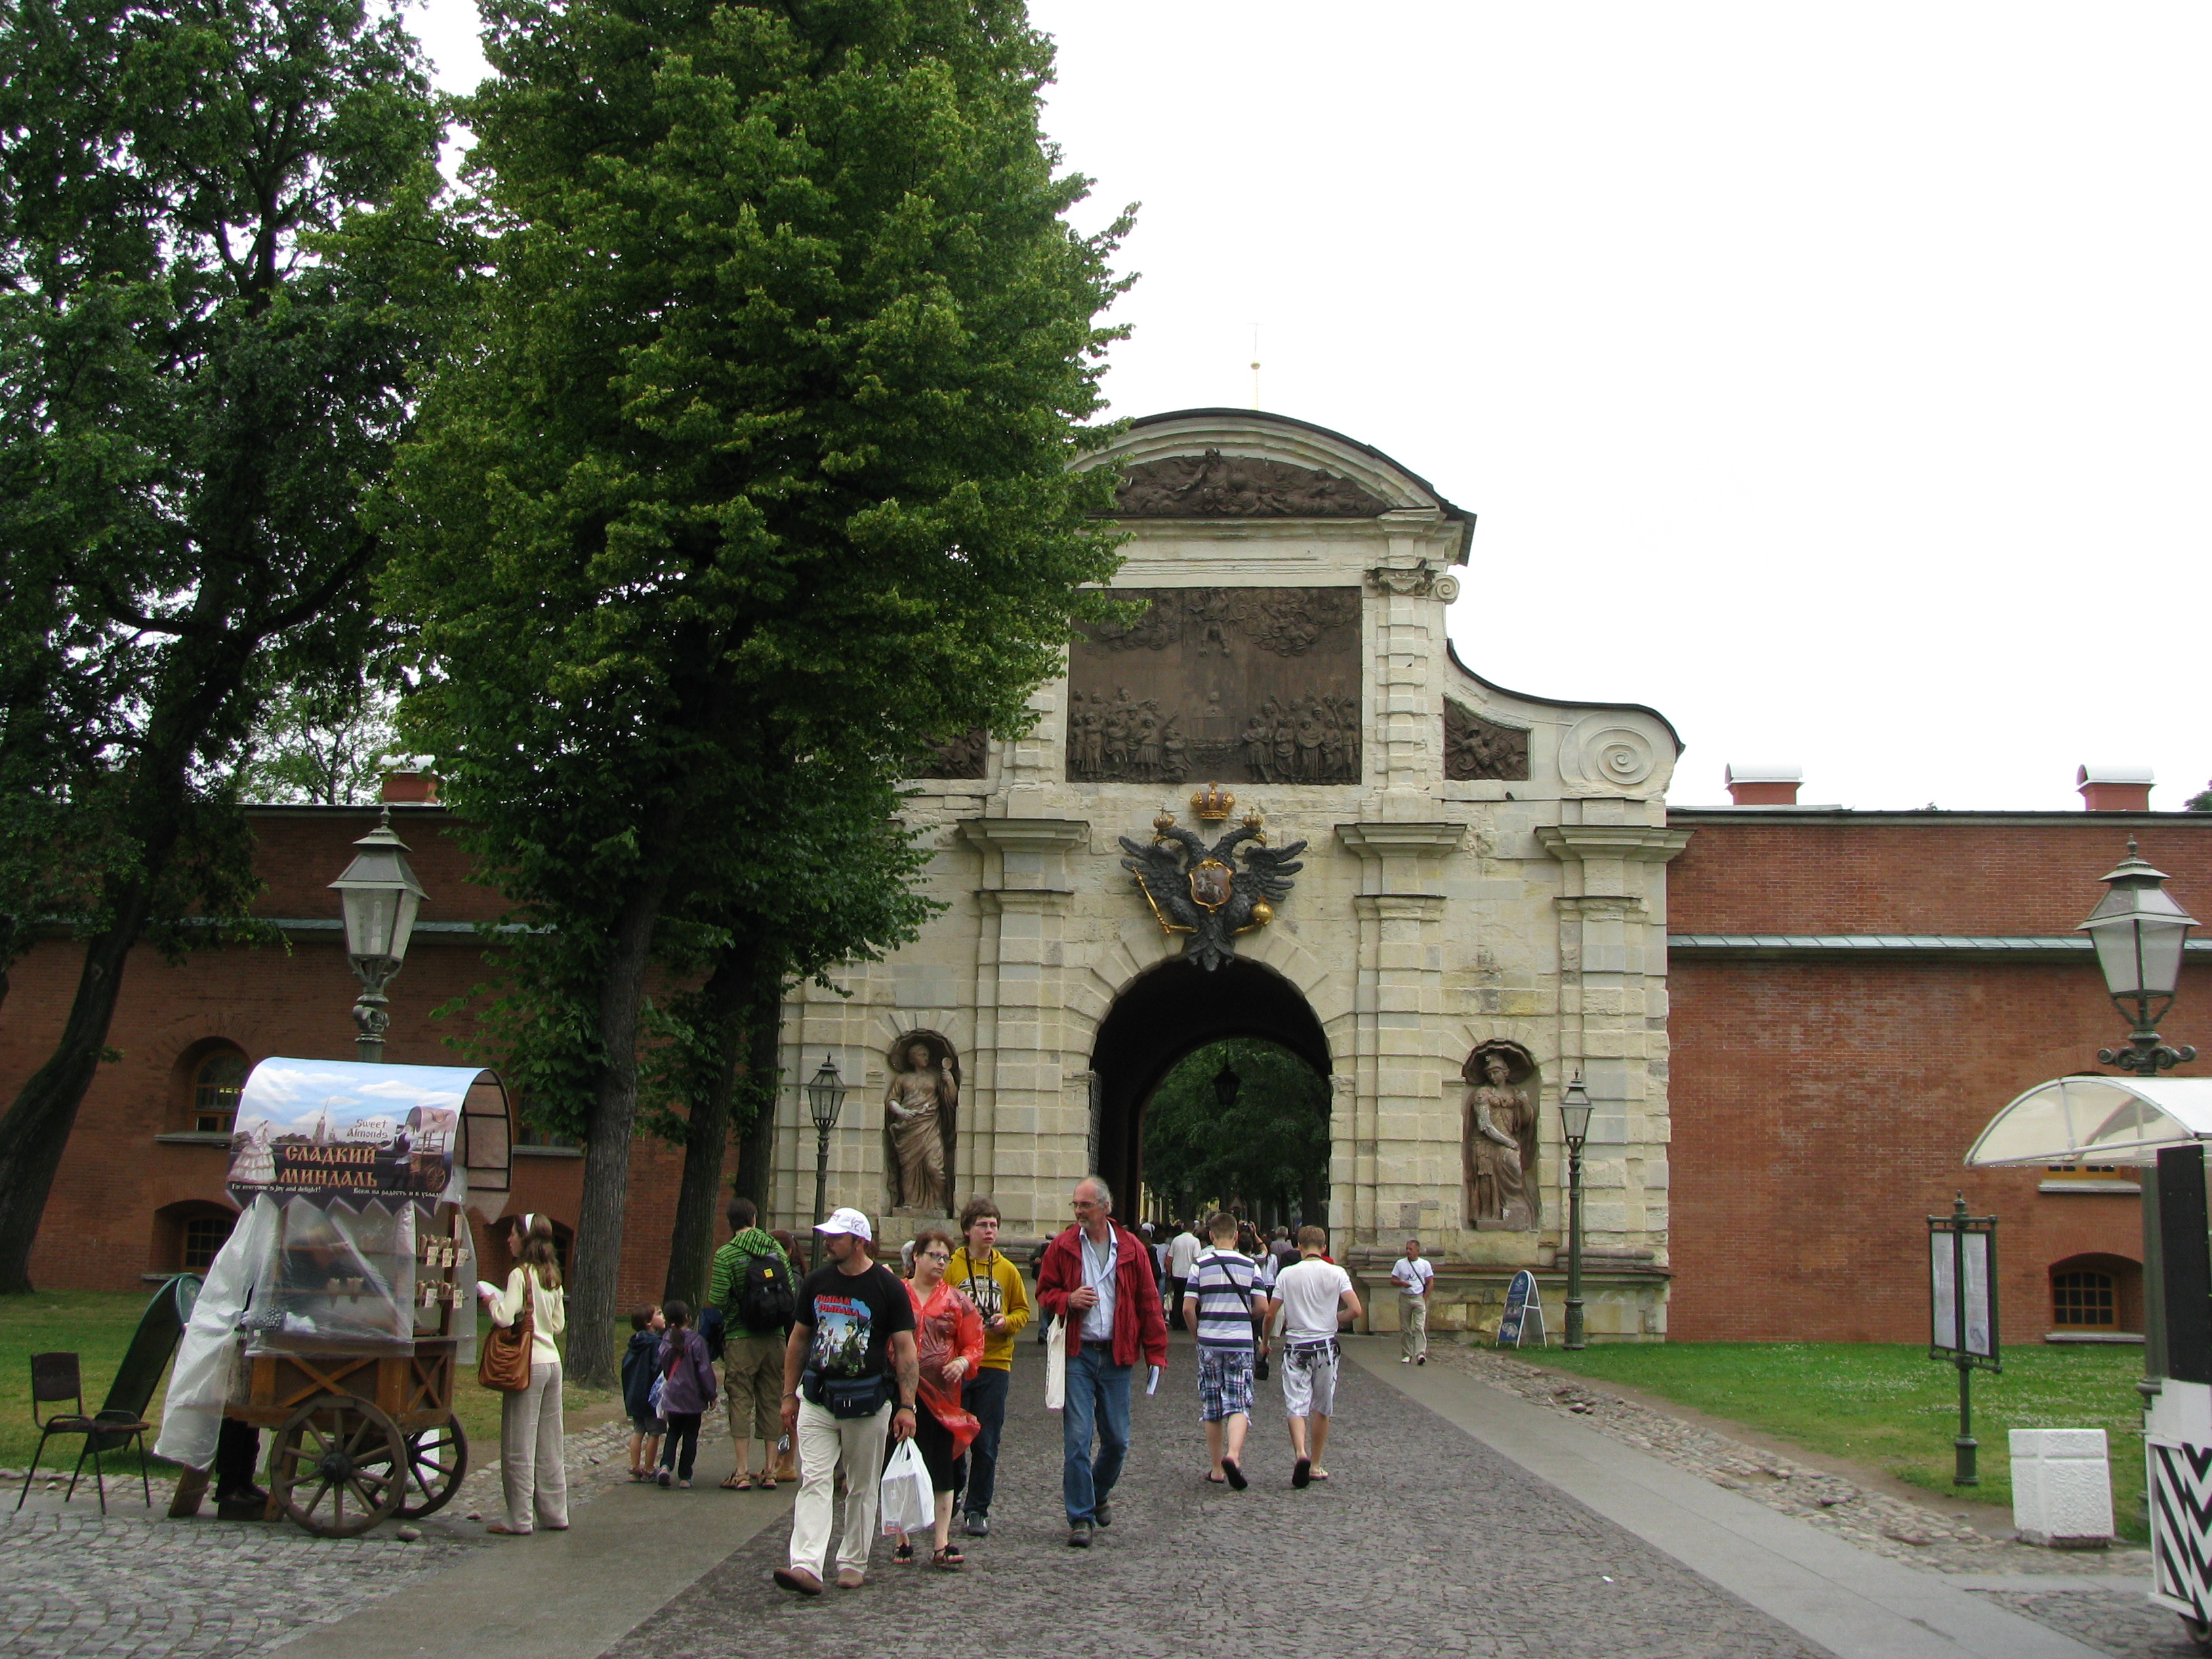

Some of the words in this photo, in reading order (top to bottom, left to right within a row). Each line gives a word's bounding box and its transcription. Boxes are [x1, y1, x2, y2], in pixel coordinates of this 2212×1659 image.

[354, 1119, 388, 1128] Sweet
[346, 1128, 388, 1139] Almonds
[285, 1145, 377, 1166] СЛАДКИЙ
[280, 1168, 377, 1187] МИНДАЛЬ
[274, 1185, 285, 1193] joy
